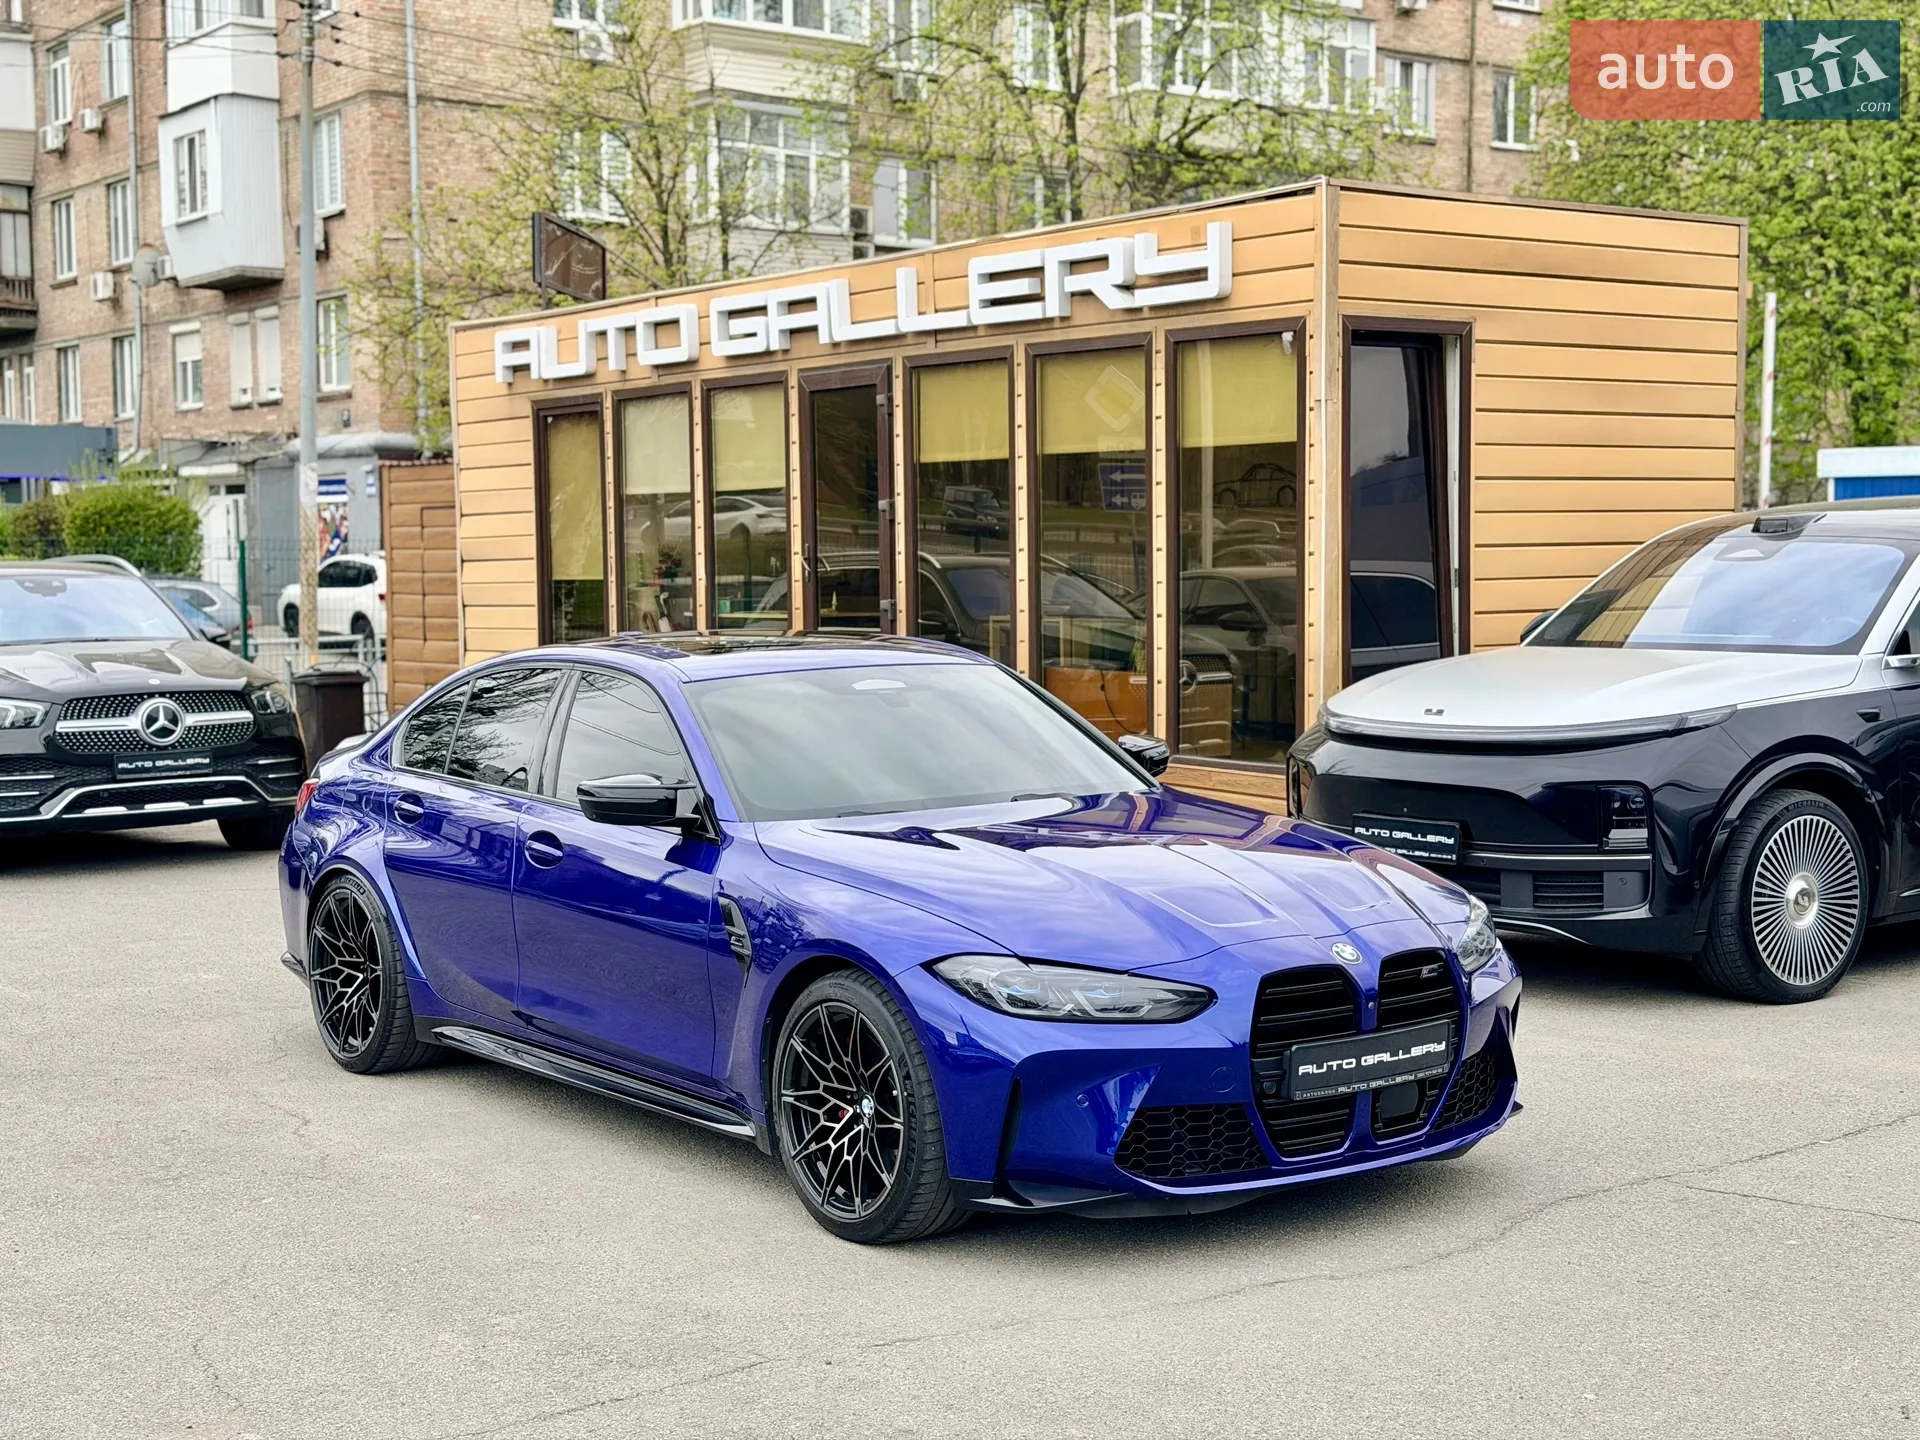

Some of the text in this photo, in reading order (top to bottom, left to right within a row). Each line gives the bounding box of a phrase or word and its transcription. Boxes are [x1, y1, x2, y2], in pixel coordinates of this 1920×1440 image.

[494, 220, 1233, 384] AUTO GALLERY
[118, 758, 210, 769] AUTO GALLERY
[1354, 826, 1455, 845] AUTO GALLERY
[1298, 1040, 1446, 1076] AUTO GALLERY
[1337, 1074, 1415, 1094] AUTO GALLERY
